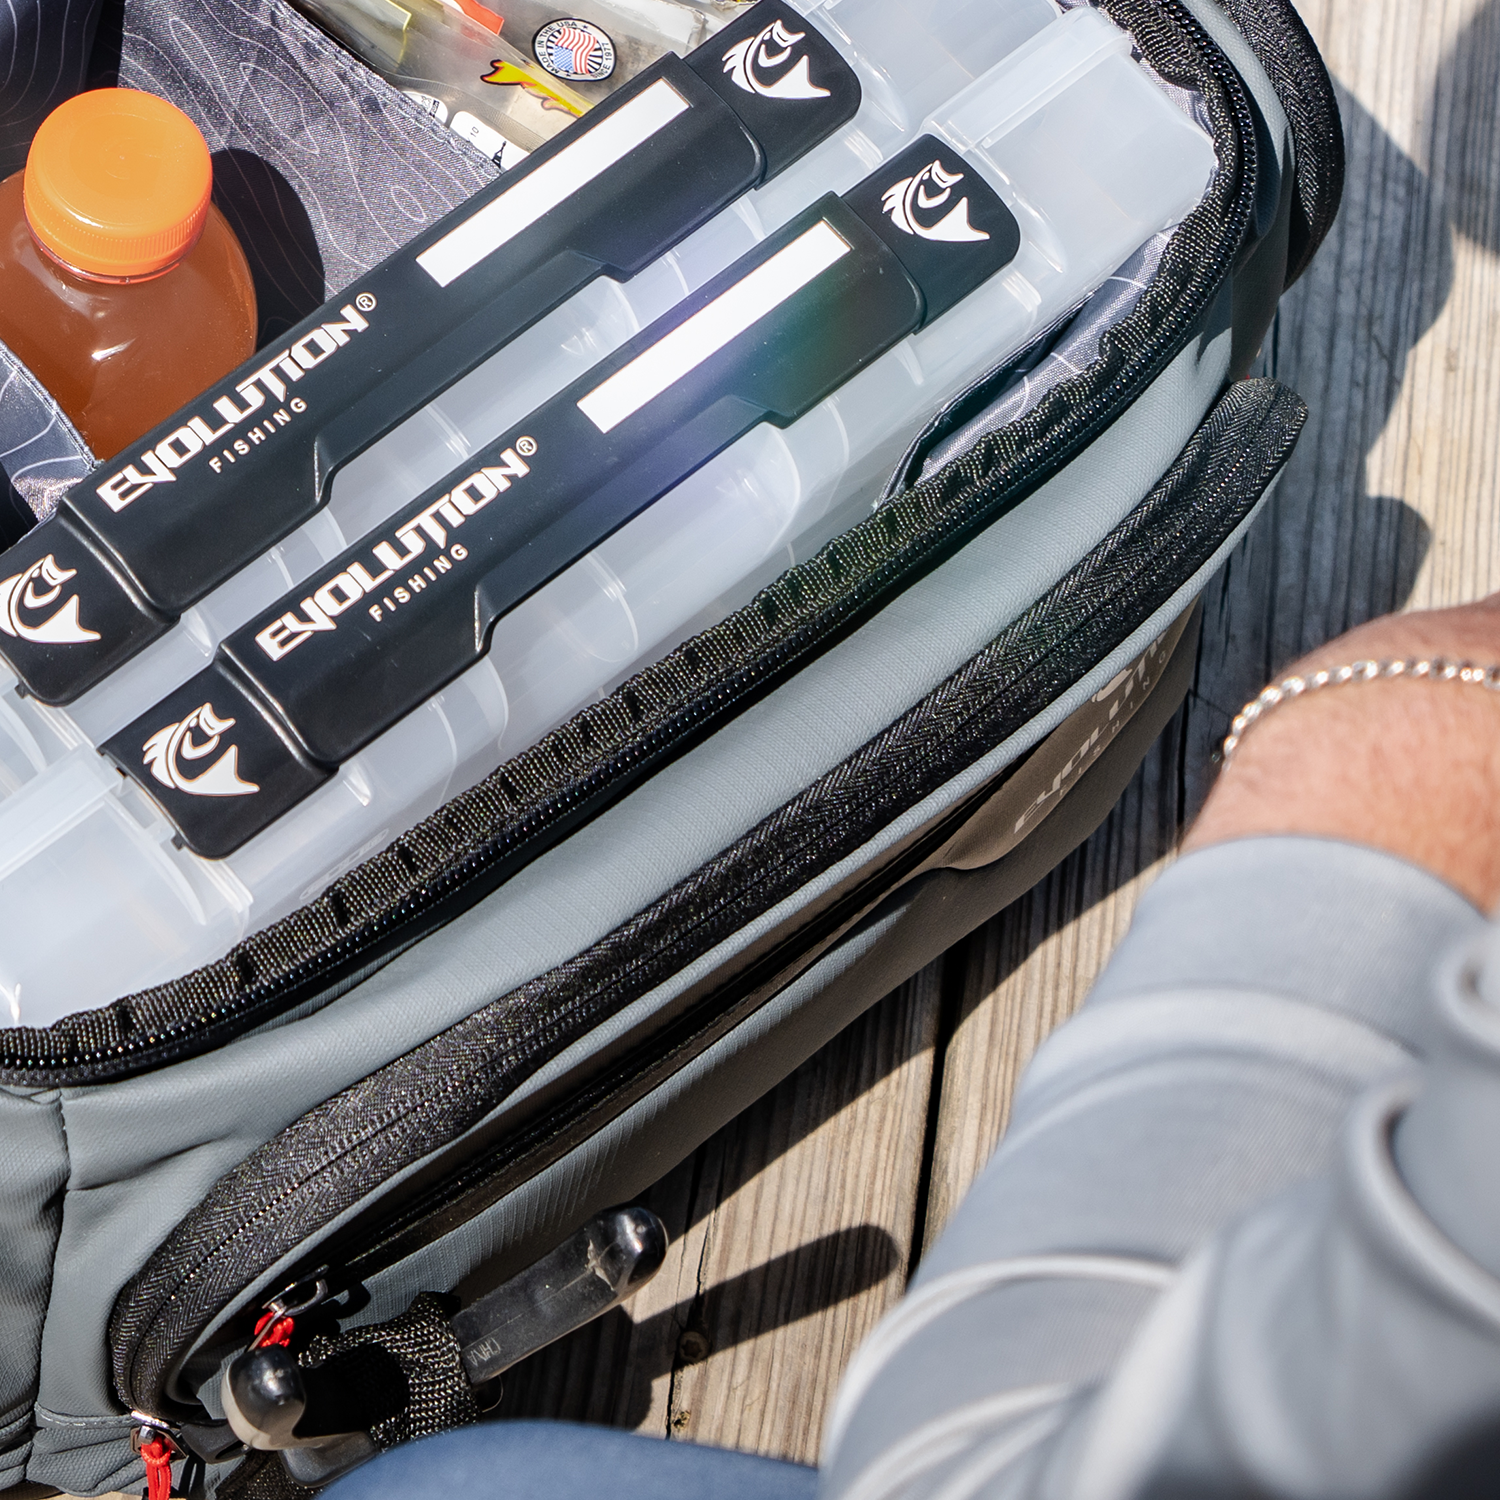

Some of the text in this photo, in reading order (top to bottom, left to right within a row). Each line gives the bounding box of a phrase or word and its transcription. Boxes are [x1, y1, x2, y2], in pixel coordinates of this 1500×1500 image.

[537, 40, 545, 48] IN
[540, 25, 555, 38] THE
[538, 51, 560, 74] MADE
[590, 42, 613, 78] SINCE 1977
[208, 397, 308, 474] FISHING
[368, 543, 469, 622] FISHING
